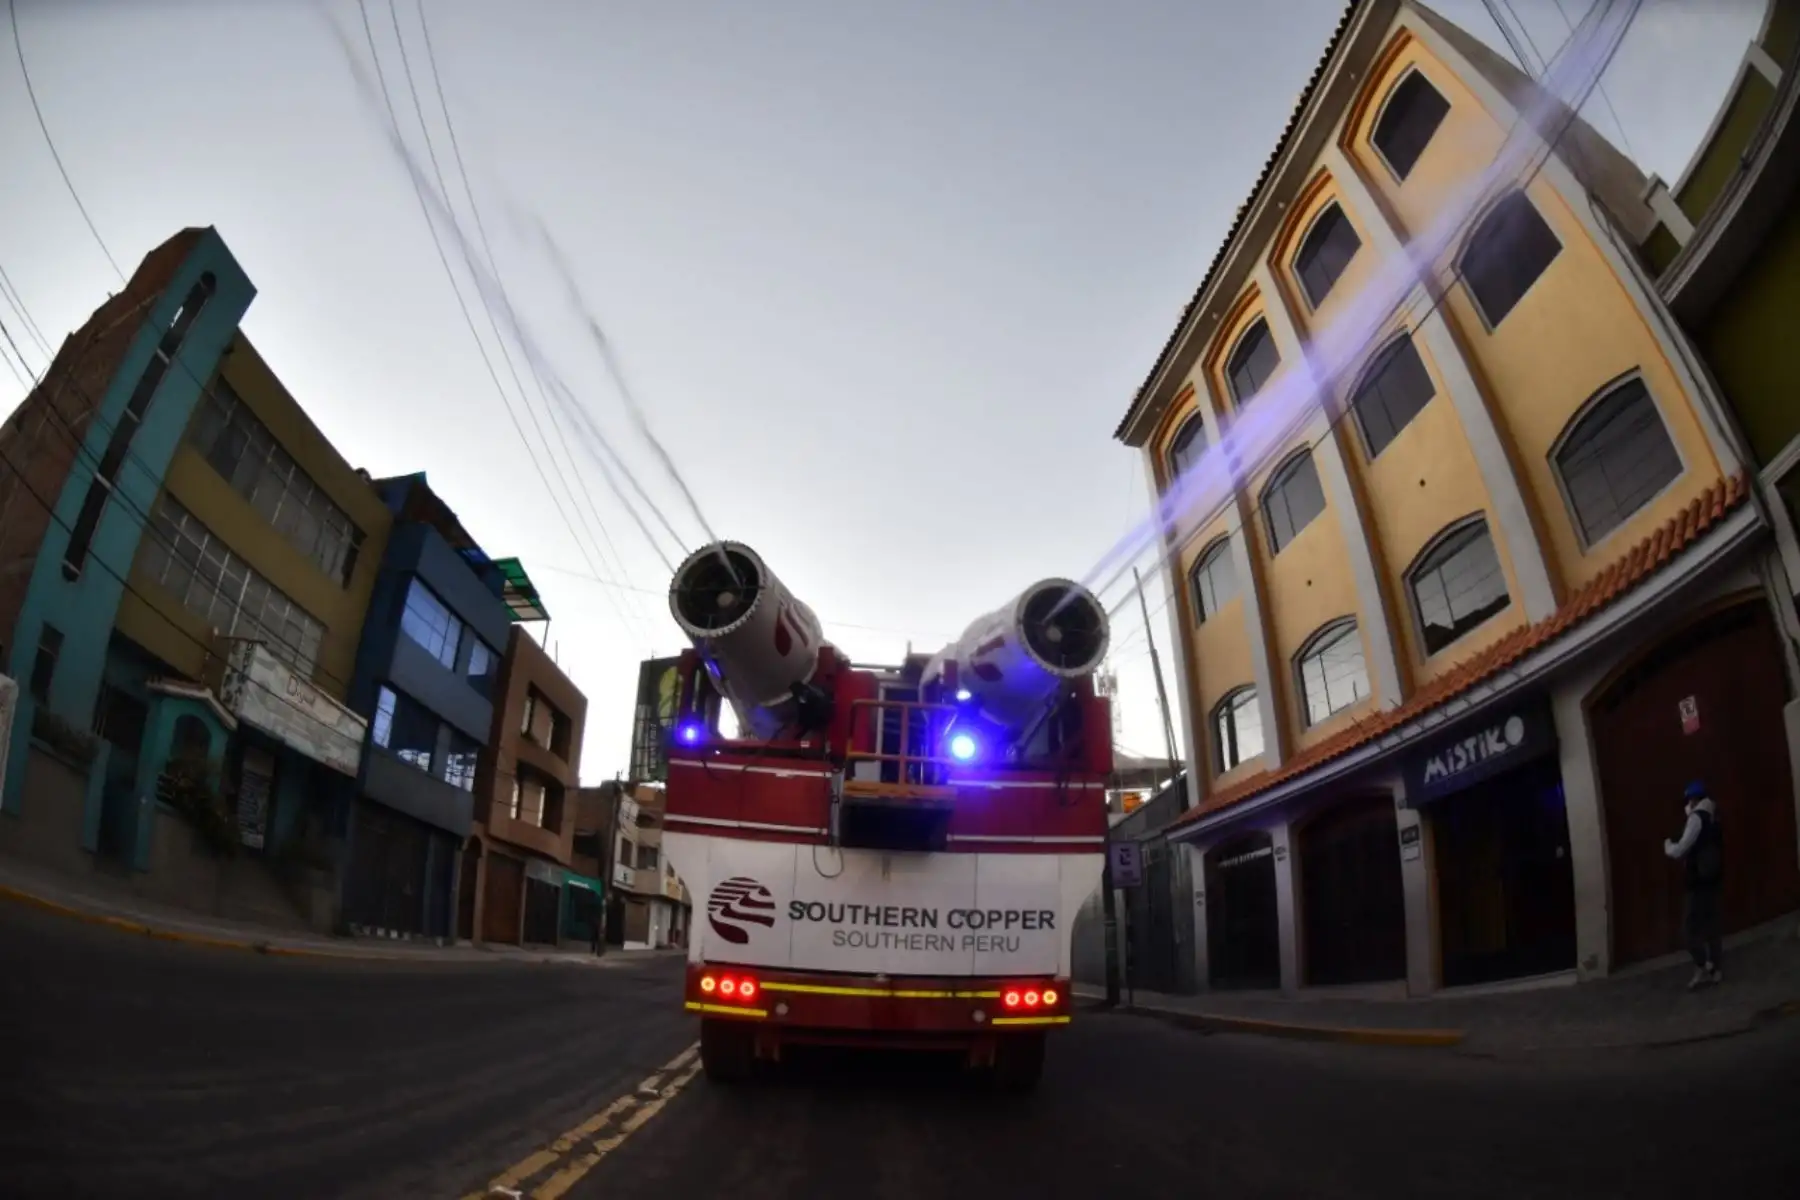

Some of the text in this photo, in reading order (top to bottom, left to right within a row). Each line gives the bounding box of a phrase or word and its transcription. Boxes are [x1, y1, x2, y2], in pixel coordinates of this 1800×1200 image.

[788, 900, 1055, 930] SOUTHERN COPPER
[832, 929, 1020, 953] SOUTHERN PERU
